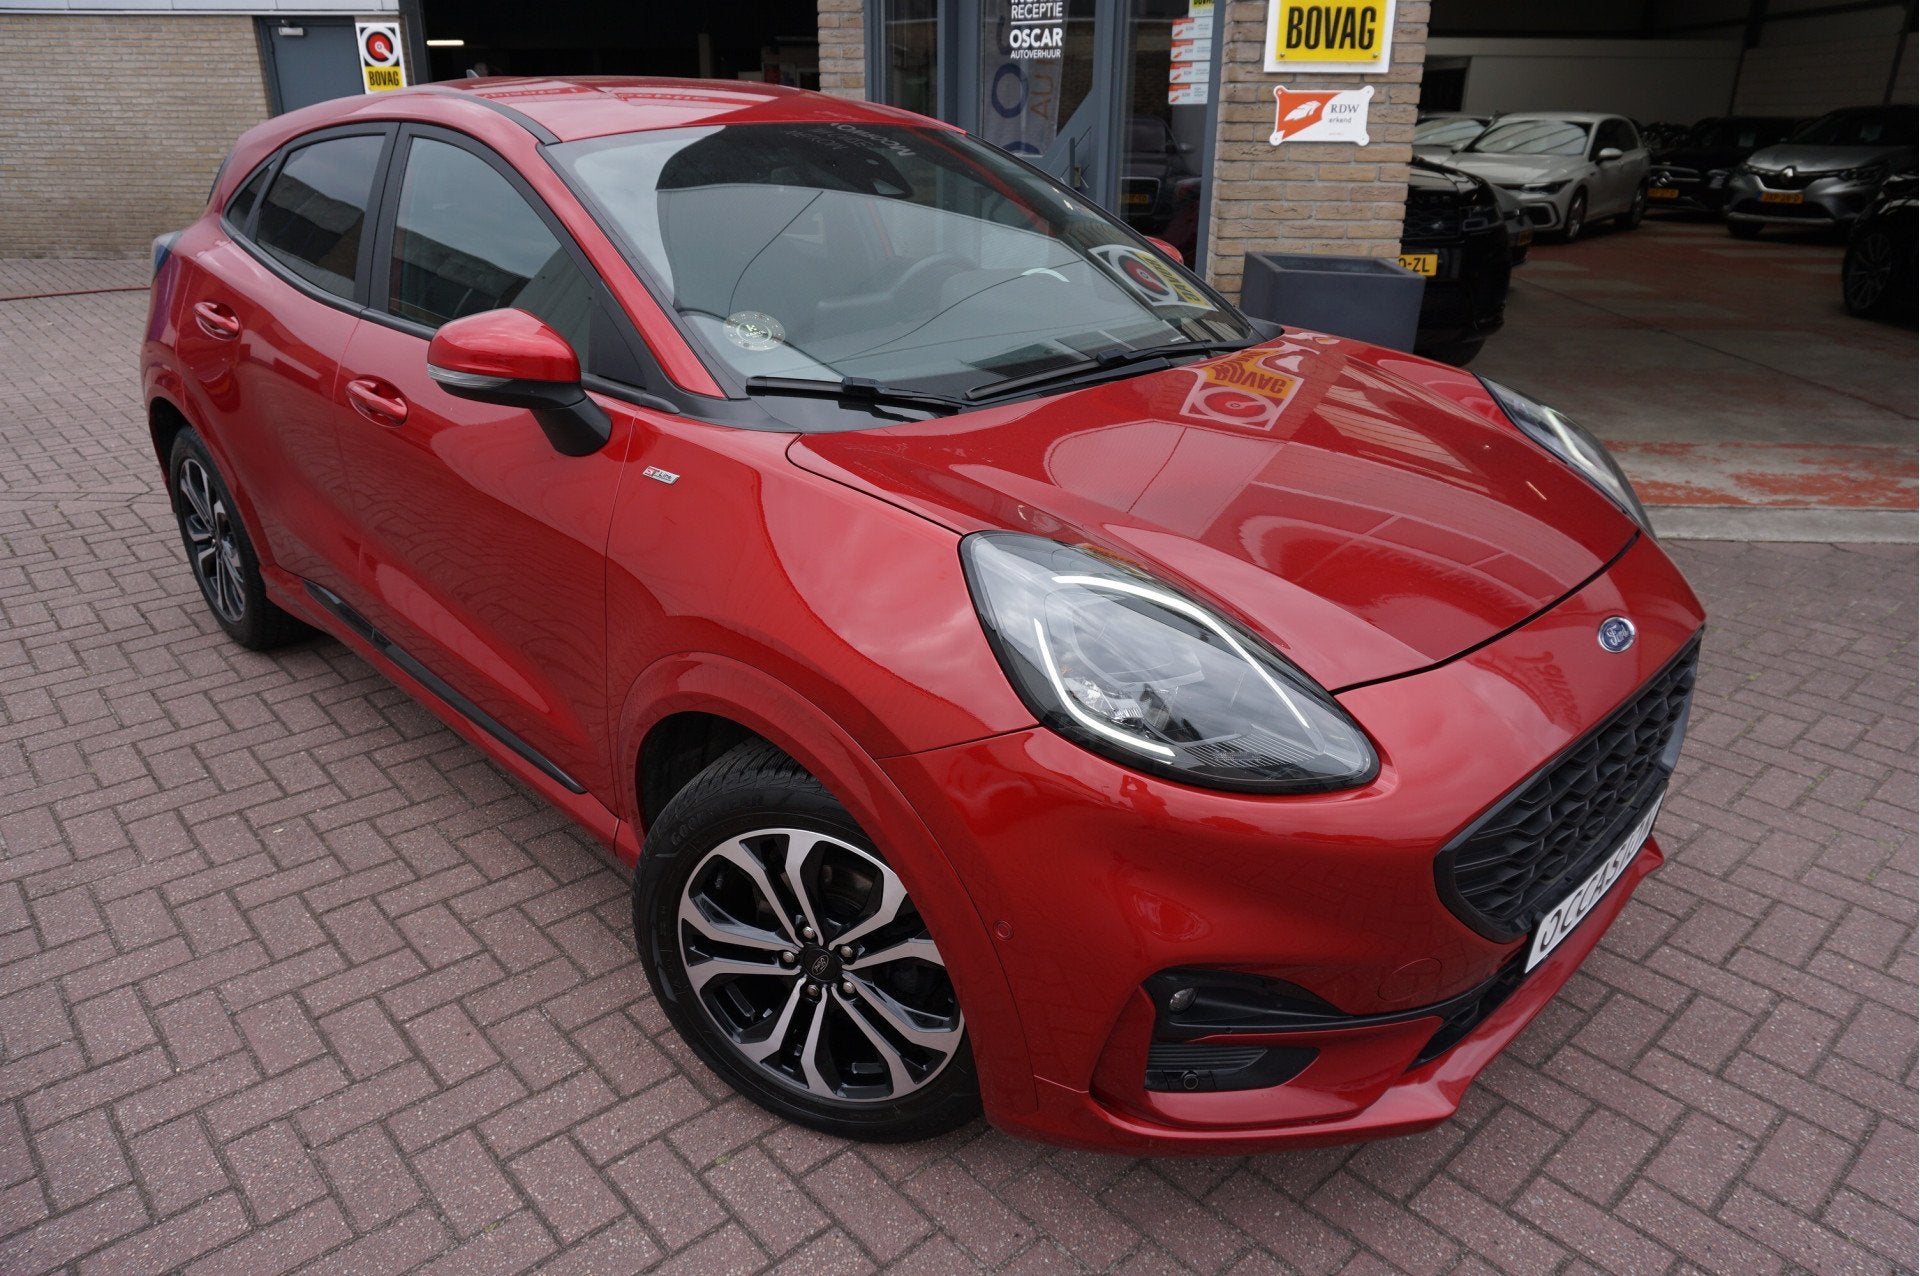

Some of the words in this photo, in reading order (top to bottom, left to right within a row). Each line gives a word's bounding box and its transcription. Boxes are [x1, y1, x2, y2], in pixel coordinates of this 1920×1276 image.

[1011, 2, 1063, 19] RECEPTIE
[1286, 6, 1377, 50] BOVAG
[1009, 28, 1063, 48] OSCAR
[1010, 49, 1062, 59] AUTOVERHUUR
[368, 71, 400, 86] BOVAG
[1331, 104, 1360, 114] RDW
[1606, 624, 1629, 646] Ford
